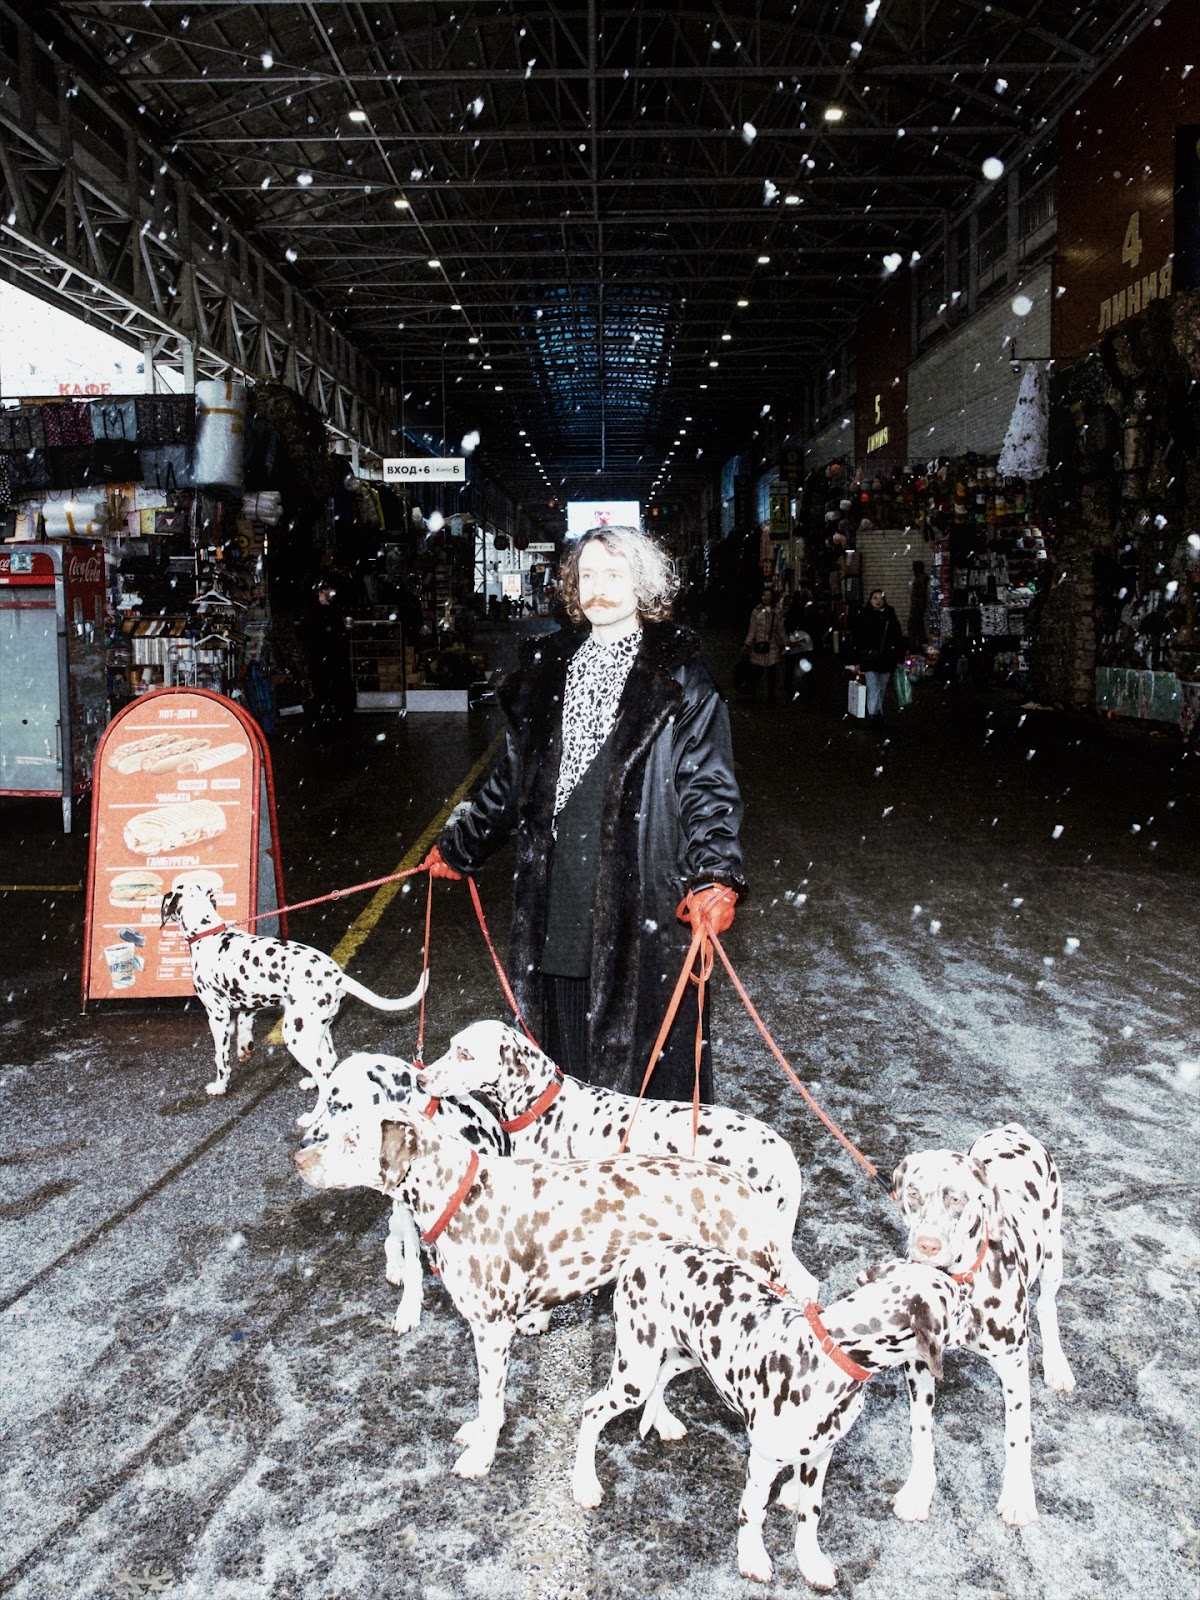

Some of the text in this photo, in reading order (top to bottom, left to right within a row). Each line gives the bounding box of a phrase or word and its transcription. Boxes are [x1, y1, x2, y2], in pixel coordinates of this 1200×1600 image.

[1121, 211, 1143, 269] 4
[1098, 262, 1173, 334] ЛИНИЯ
[58, 383, 113, 395] КАФЕ
[874, 394, 881, 425] 5
[387, 466, 417, 475] ВХОД
[423, 466, 430, 474] 6
[453, 466, 460, 474] Б
[159, 709, 198, 719] ХОТ-ДОГИ
[146, 856, 200, 867] ГАМБУРГЕРЫ
